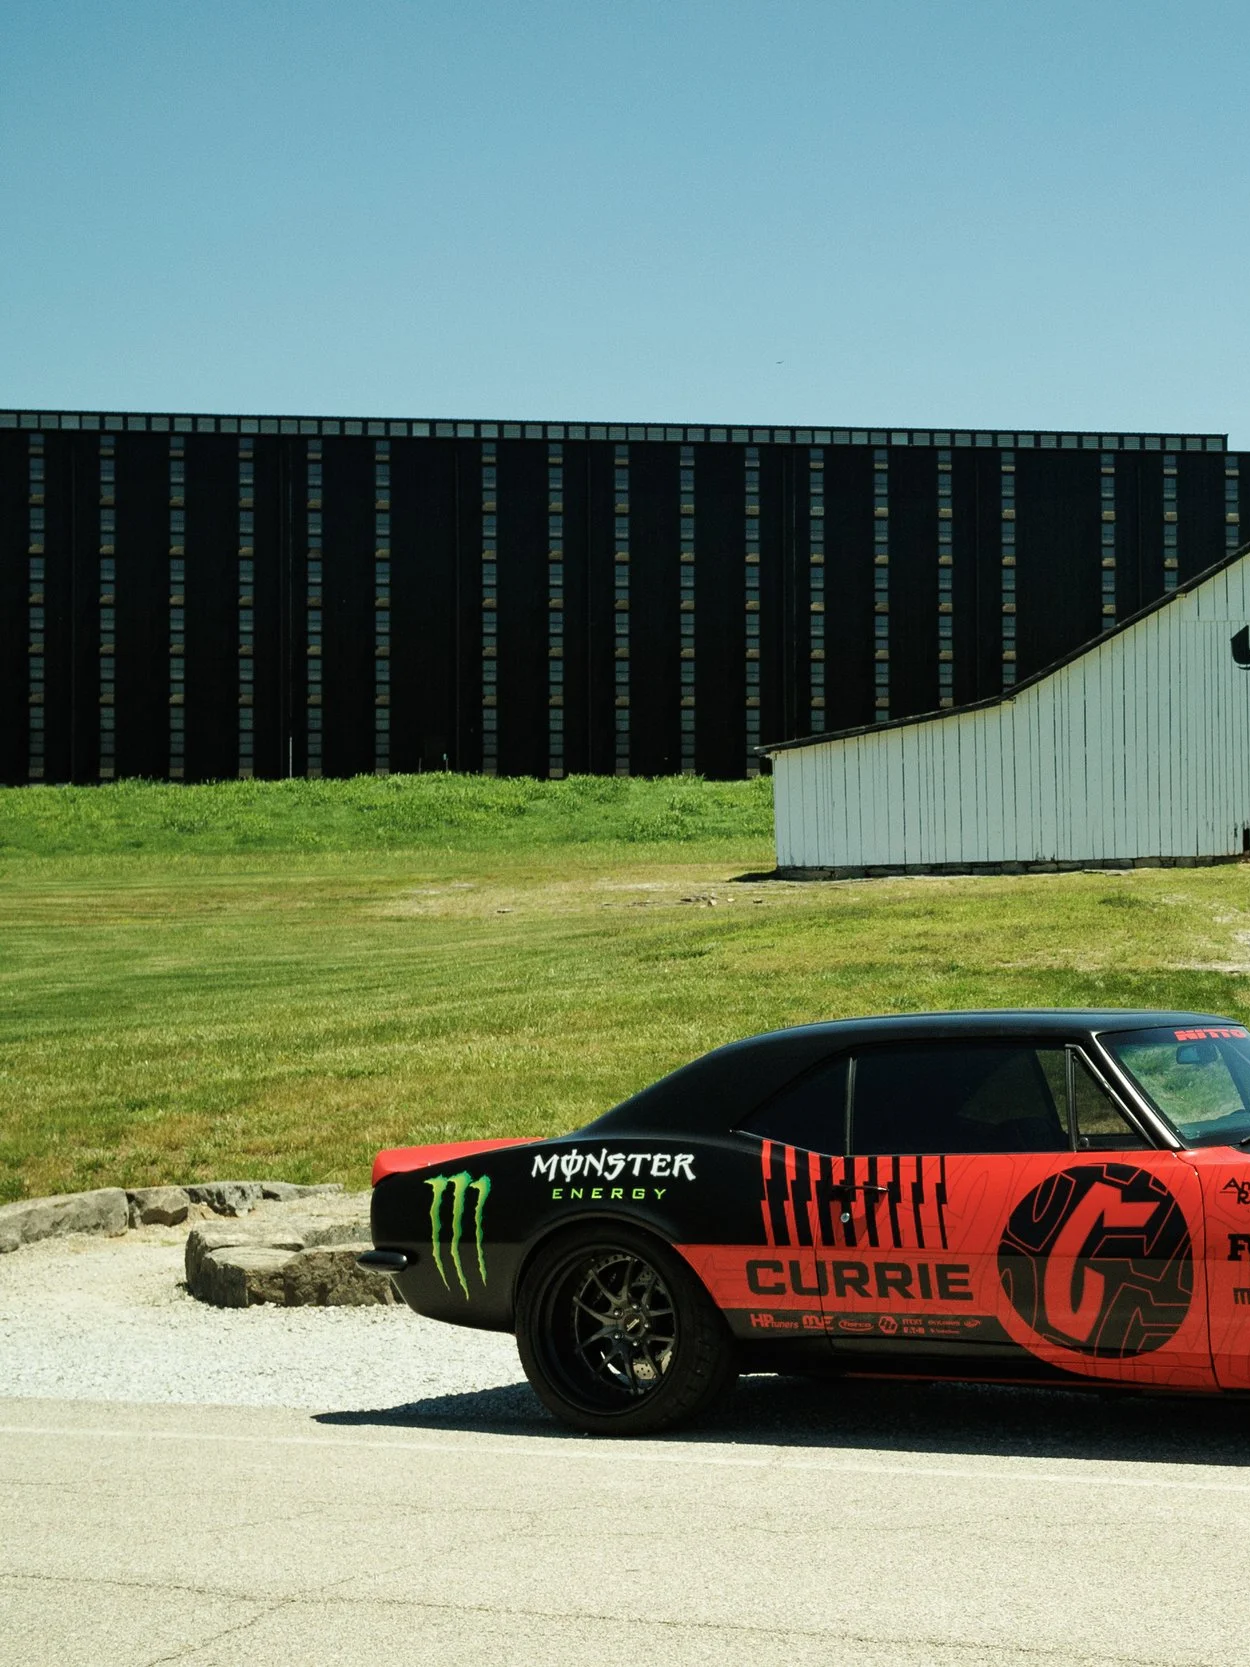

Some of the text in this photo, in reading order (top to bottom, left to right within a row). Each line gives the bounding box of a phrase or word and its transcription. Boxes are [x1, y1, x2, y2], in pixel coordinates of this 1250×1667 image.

[1174, 1028, 1247, 1041] NITTO
[530, 1148, 697, 1183] MONSTER
[552, 1187, 667, 1200] ENERGY
[745, 1259, 974, 1301] CURRIE
